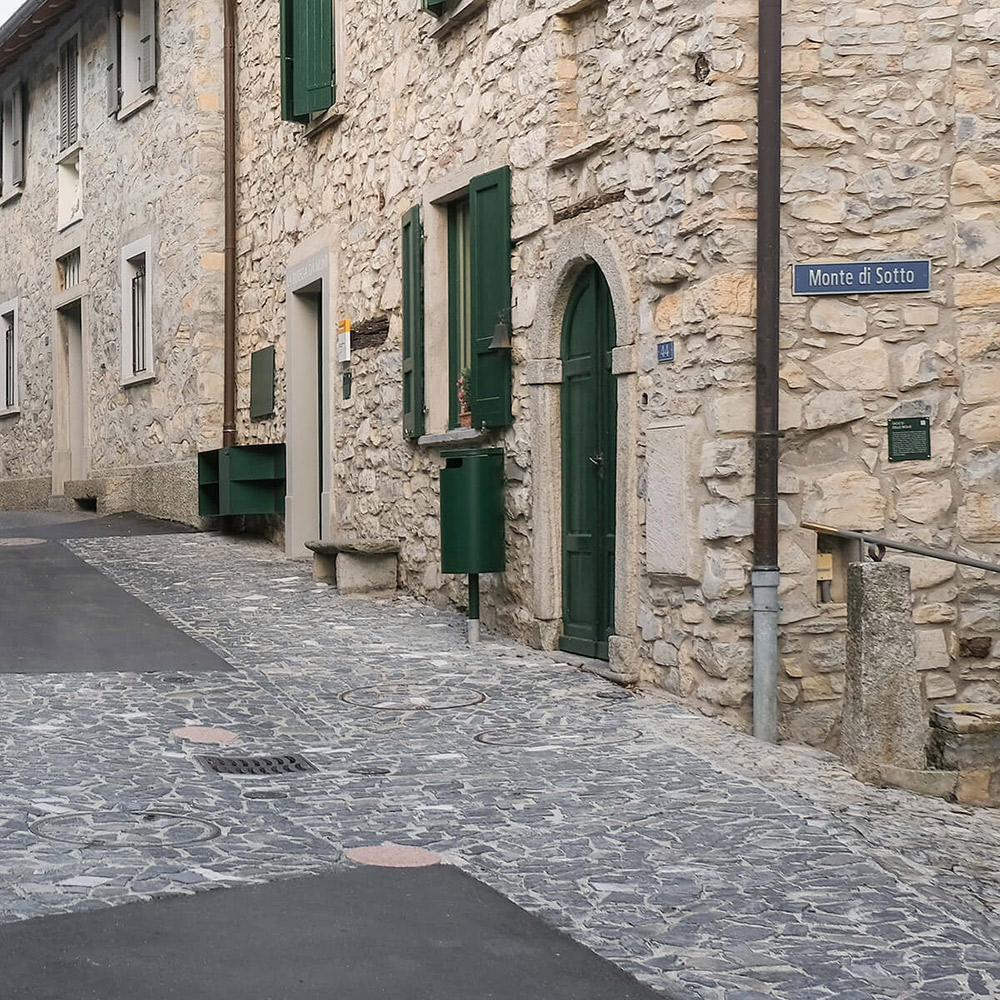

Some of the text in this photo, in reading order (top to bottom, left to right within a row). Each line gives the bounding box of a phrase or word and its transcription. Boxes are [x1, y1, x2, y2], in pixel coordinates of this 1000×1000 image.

[809, 267, 915, 286] Monte di Sotto
